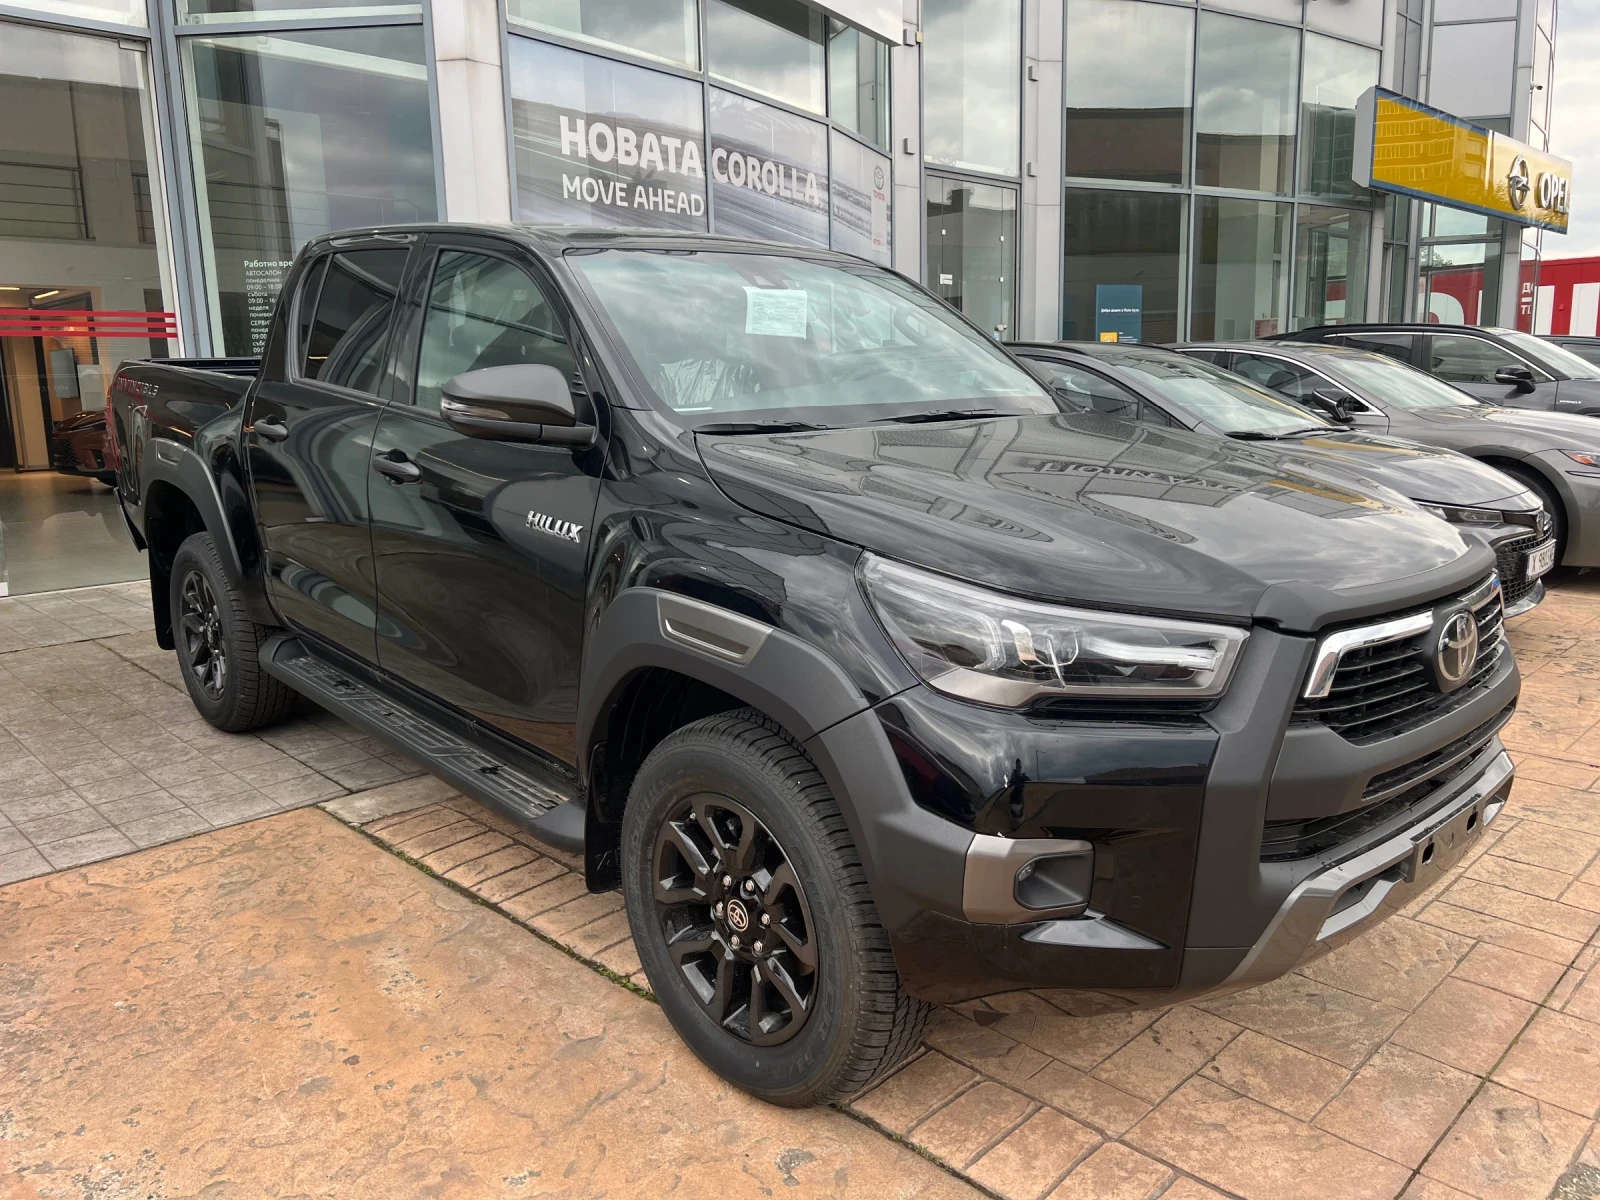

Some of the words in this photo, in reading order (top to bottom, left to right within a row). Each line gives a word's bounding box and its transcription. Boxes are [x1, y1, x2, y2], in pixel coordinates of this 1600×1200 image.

[562, 174, 628, 207] MOVE
[633, 185, 705, 217] AHEAD
[711, 147, 819, 204] COROLLA
[1534, 171, 1572, 214] OPEL
[244, 260, 277, 268] Работно
[526, 510, 583, 543] HILUX
